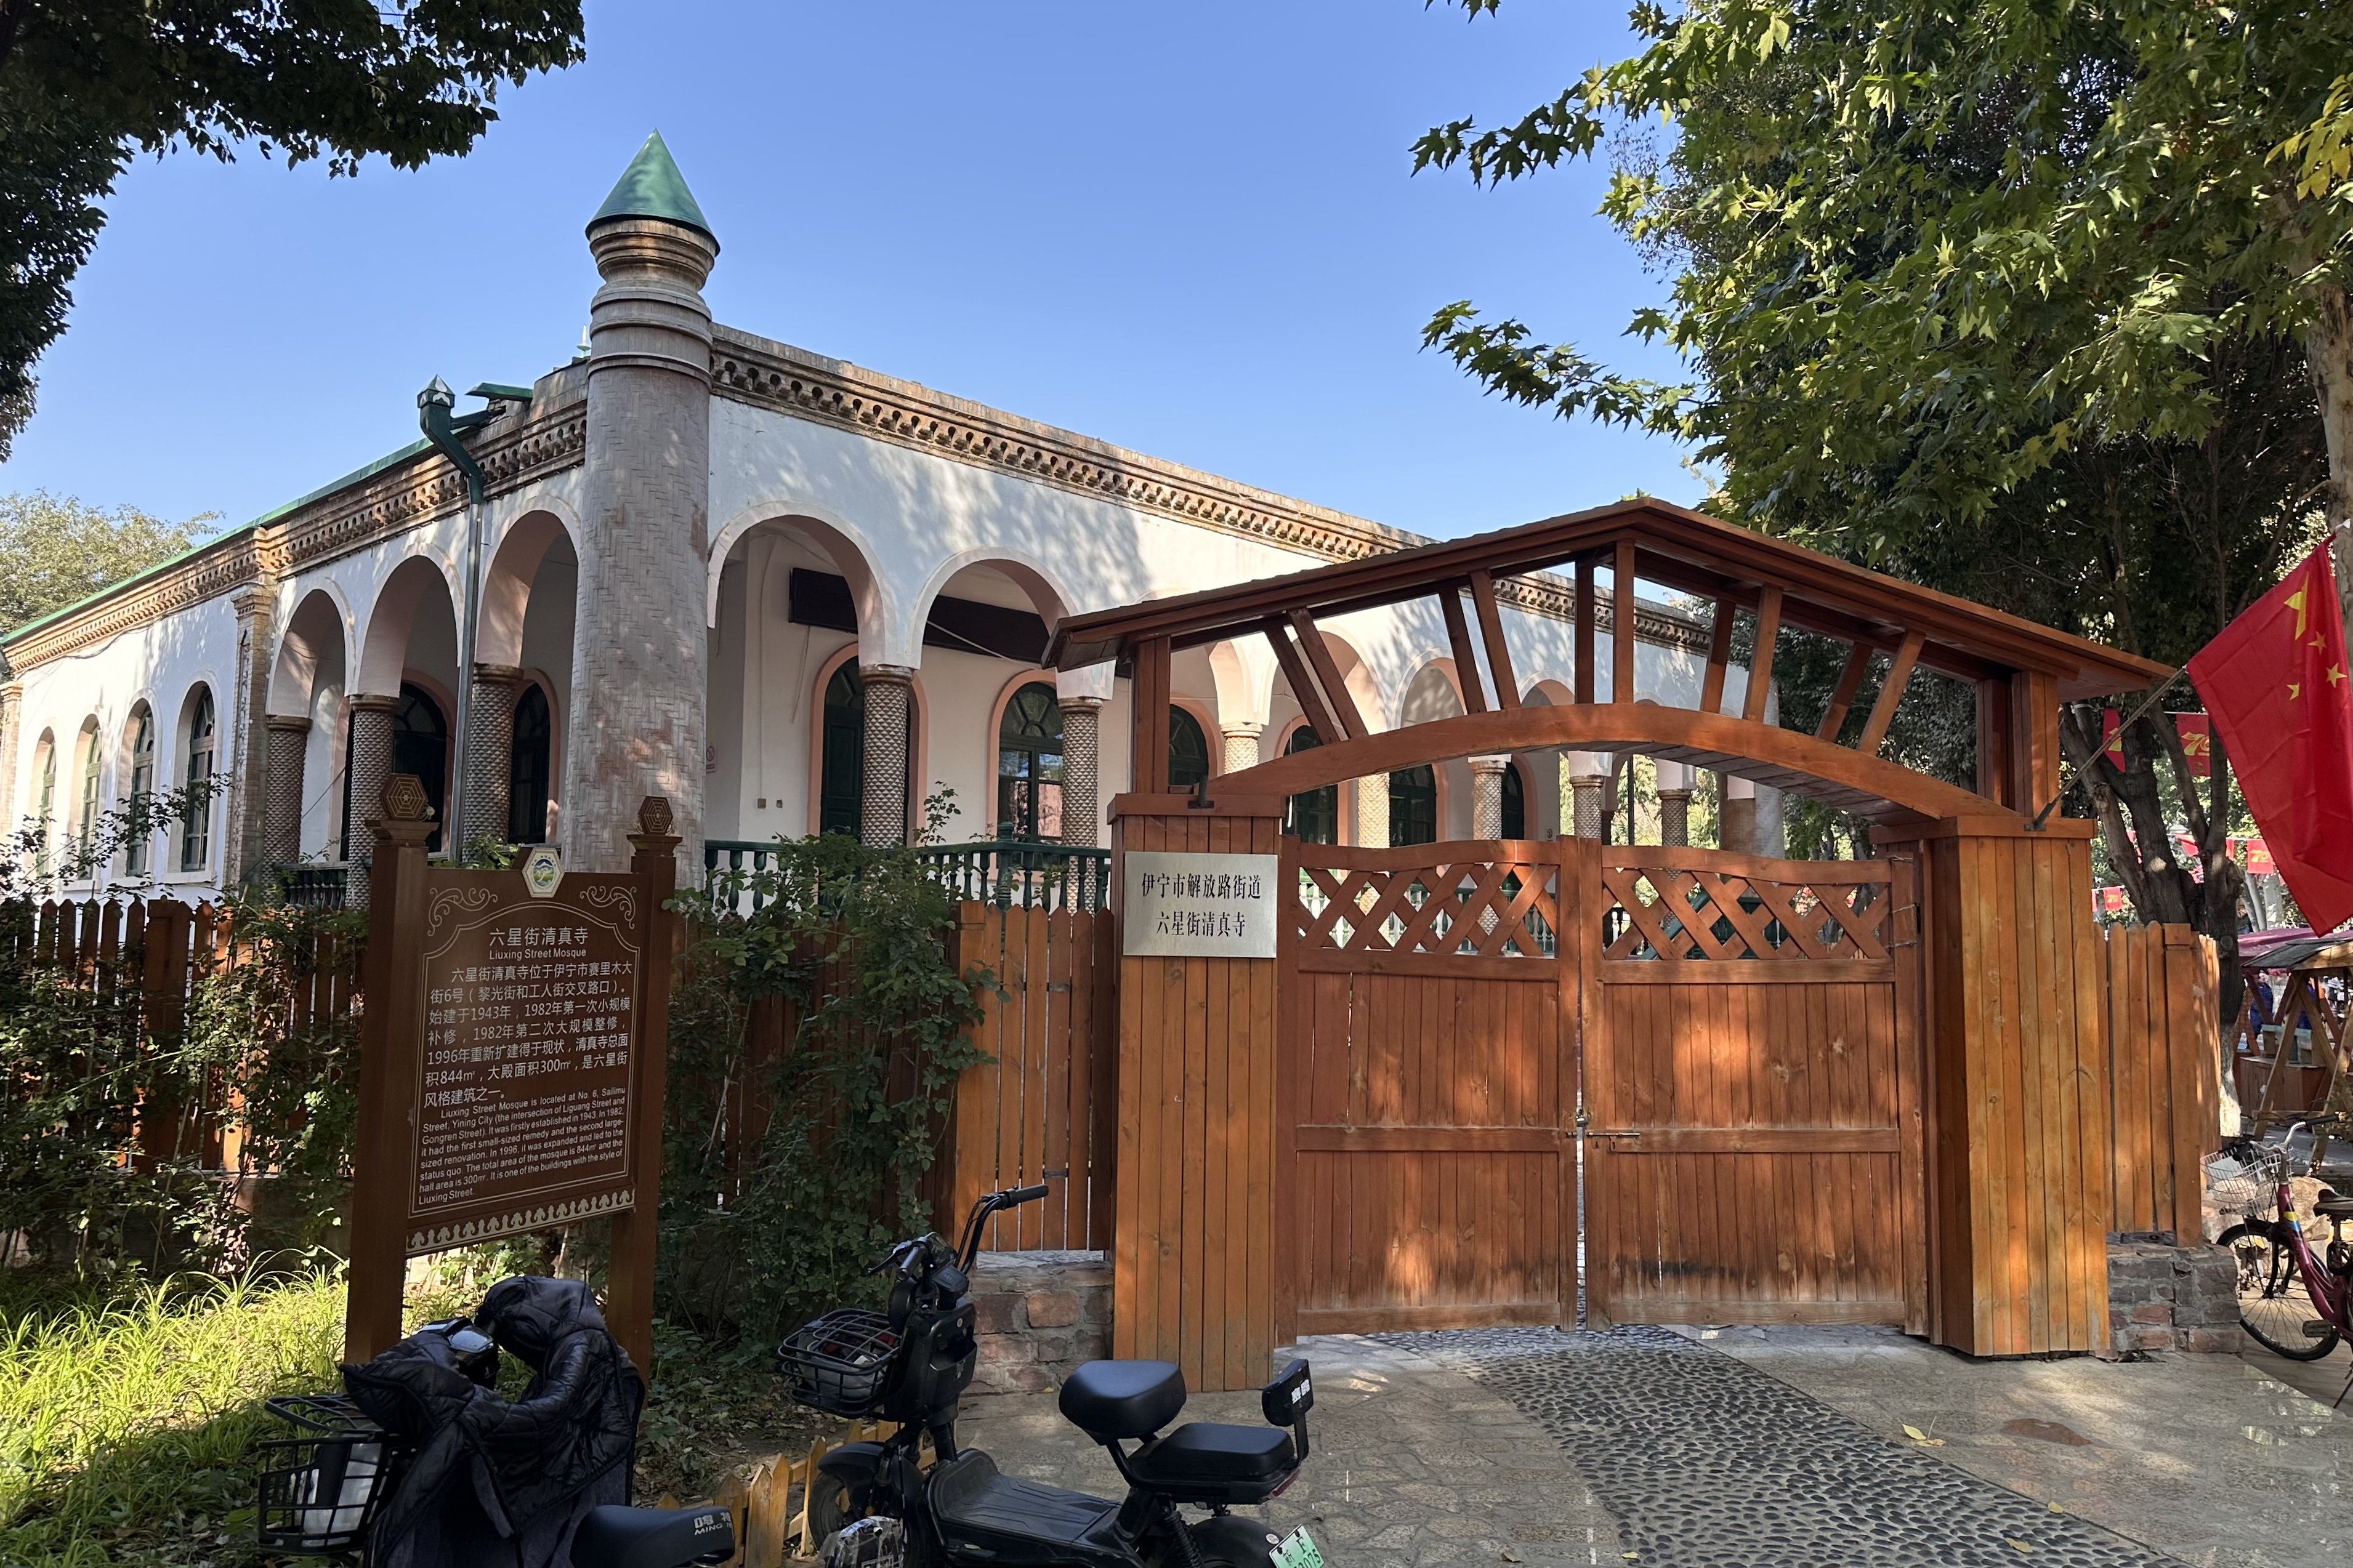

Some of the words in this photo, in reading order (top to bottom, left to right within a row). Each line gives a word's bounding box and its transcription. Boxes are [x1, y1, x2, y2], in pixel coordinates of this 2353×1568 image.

[1142, 873, 1261, 899] 伊宁市解放路街道
[490, 926, 588, 946] 六星街清真寺
[1156, 911, 1245, 937] 六星街清真寺
[490, 949, 522, 961] Liuxing
[525, 948, 551, 959] Street
[554, 948, 586, 959] Mosque
[451, 960, 632, 983] 六星街清真寺位于伊宁市赛里木大
[424, 1086, 504, 1109] 风格建筑之一。
[441, 1108, 469, 1118] Liuxing
[473, 1104, 496, 1114] Street
[499, 1101, 528, 1111] Mosque
[540, 1094, 565, 1104] located
[592, 1090, 599, 1098] 6,
[602, 1087, 625, 1096] Sailimu
[422, 1122, 450, 1132] Street,
[452, 1119, 475, 1128] Yining
[478, 1116, 493, 1125] City
[495, 1112, 509, 1124] (the
[511, 1108, 552, 1120] intersection
[554, 1105, 562, 1113] of
[563, 1102, 590, 1113] Liguang
[592, 1100, 611, 1108] Street
[613, 1096, 624, 1104] and
[421, 1148, 426, 1157] it
[429, 1146, 444, 1156] had
[446, 1144, 459, 1152] the
[461, 1141, 476, 1151] first
[478, 1134, 520, 1148] small-sized
[522, 1130, 549, 1141] remedy
[551, 1127, 564, 1136] and
[567, 1124, 577, 1133] the
[579, 1120, 603, 1132] second
[605, 1119, 624, 1128] large-
[422, 1133, 457, 1144] Gongren
[459, 1128, 486, 1140] Street).
[488, 1127, 493, 1135] It
[511, 1120, 530, 1133] firstly
[531, 1116, 571, 1127] established
[420, 1172, 444, 1181] status
[466, 1164, 480, 1173] The
[483, 1160, 499, 1170] total
[500, 1158, 517, 1167] area
[519, 1154, 526, 1164] of
[527, 1153, 538, 1162] the
[540, 1149, 568, 1160] mosque
[599, 1141, 610, 1149] and
[421, 1157, 442, 1168] sized
[445, 1152, 488, 1165] renovation.
[490, 1149, 497, 1157] In
[522, 1144, 526, 1152] it
[528, 1142, 541, 1151] was
[544, 1137, 578, 1149] expanded
[579, 1133, 592, 1142] and
[419, 1183, 434, 1192] hall
[435, 1180, 453, 1190] area
[490, 1172, 495, 1180] It
[504, 1168, 518, 1177] one
[520, 1166, 527, 1175] of
[528, 1165, 539, 1173] the
[541, 1159, 571, 1171] buildings
[573, 1156, 586, 1165] with
[588, 1154, 598, 1162] the
[599, 1151, 615, 1162] style
[616, 1149, 623, 1157] of
[419, 1194, 448, 1205] Liuxing
[695, 1523, 723, 1535] MING
[1296, 1537, 1306, 1554] F
